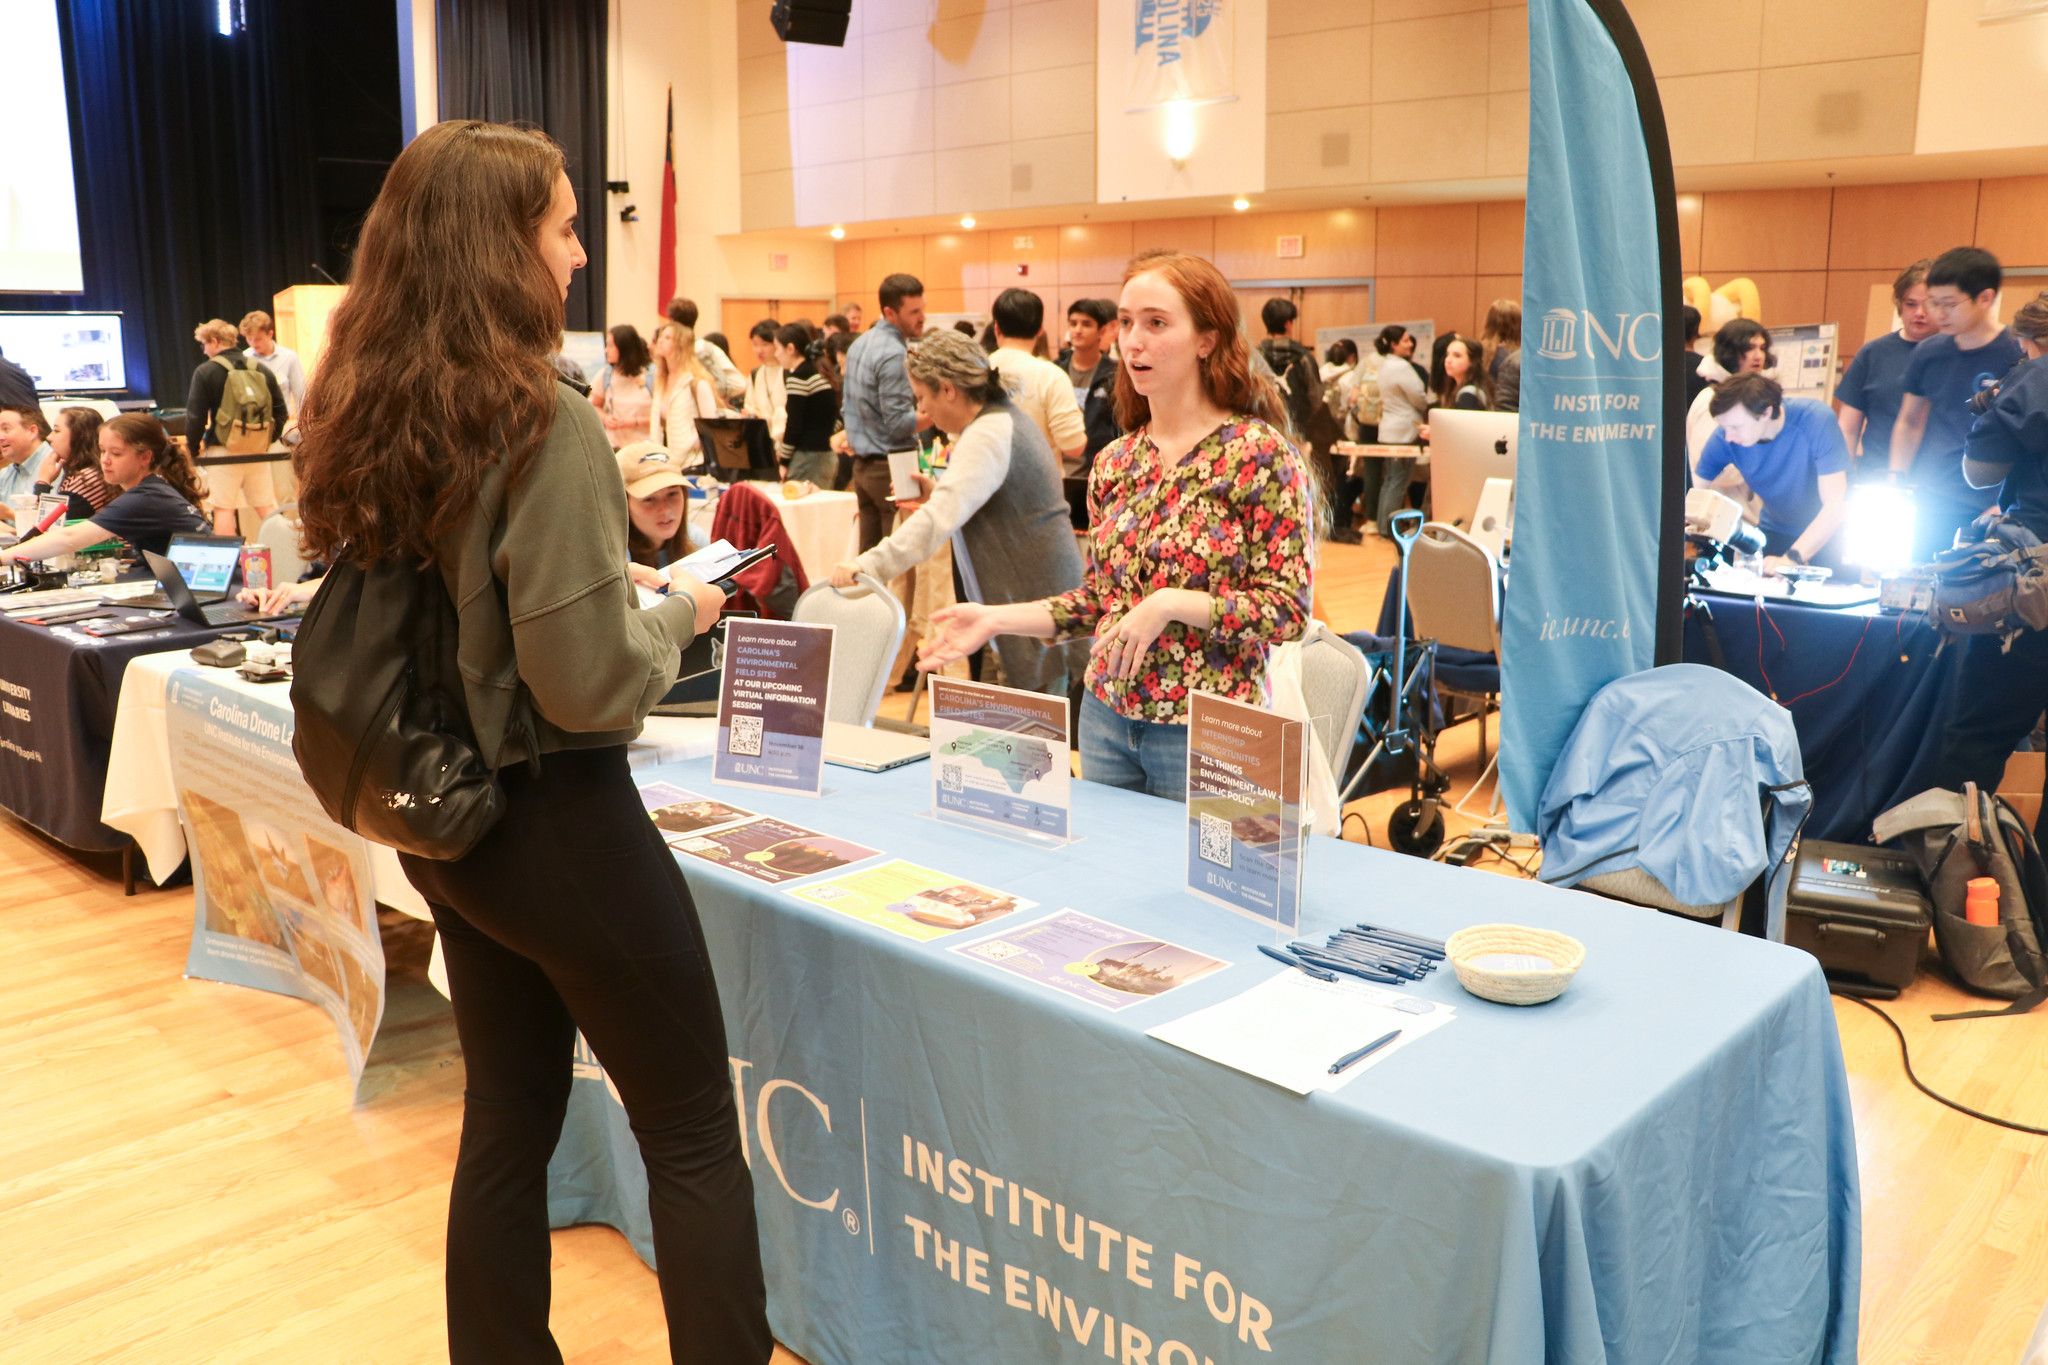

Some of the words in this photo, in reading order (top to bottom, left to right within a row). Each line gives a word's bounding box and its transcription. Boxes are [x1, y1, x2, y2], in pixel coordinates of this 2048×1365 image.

[1604, 393, 1640, 411] FOR
[1529, 422, 1567, 442] THE
[737, 635, 757, 643] Learn
[757, 637, 776, 645] more
[776, 637, 797, 647] about
[737, 646, 780, 657] CAROLINA'S
[735, 668, 756, 677] FIELD
[757, 670, 777, 679] SITES
[736, 657, 798, 670] ENVIRONMENTAL
[745, 680, 761, 688] OUR
[762, 681, 802, 692] UPCOMING
[732, 689, 763, 699] VIRTUAL
[764, 692, 817, 705] INFORMATION
[732, 700, 763, 710] SESSION
[939, 693, 984, 707] CAROLINA'S
[985, 700, 1052, 720] ENVIRONMENTAL
[209, 696, 249, 729] Carolina
[249, 711, 280, 742] Drone
[281, 723, 295, 747] La
[1201, 713, 1220, 726] Learn
[1221, 720, 1240, 732] more
[1241, 725, 1263, 738] about
[1201, 728, 1246, 747] INTERNSHIP
[1200, 741, 1261, 767] OPPORTUNITIES
[1200, 755, 1214, 767] ALL
[1215, 759, 1243, 775] THINGS
[1200, 768, 1256, 795] ENVIRONMENT,
[1257, 787, 1277, 800] LAW
[1200, 782, 1227, 797] PUBLIC
[1227, 790, 1255, 807] POLICY
[1213, 873, 1237, 894] UNC
[903, 1134, 1153, 1289] INSTITUTE
[1174, 1252, 1273, 1352] FOR
[904, 1214, 991, 1295] THE
[1003, 1263, 1214, 1365] ENVIRO
